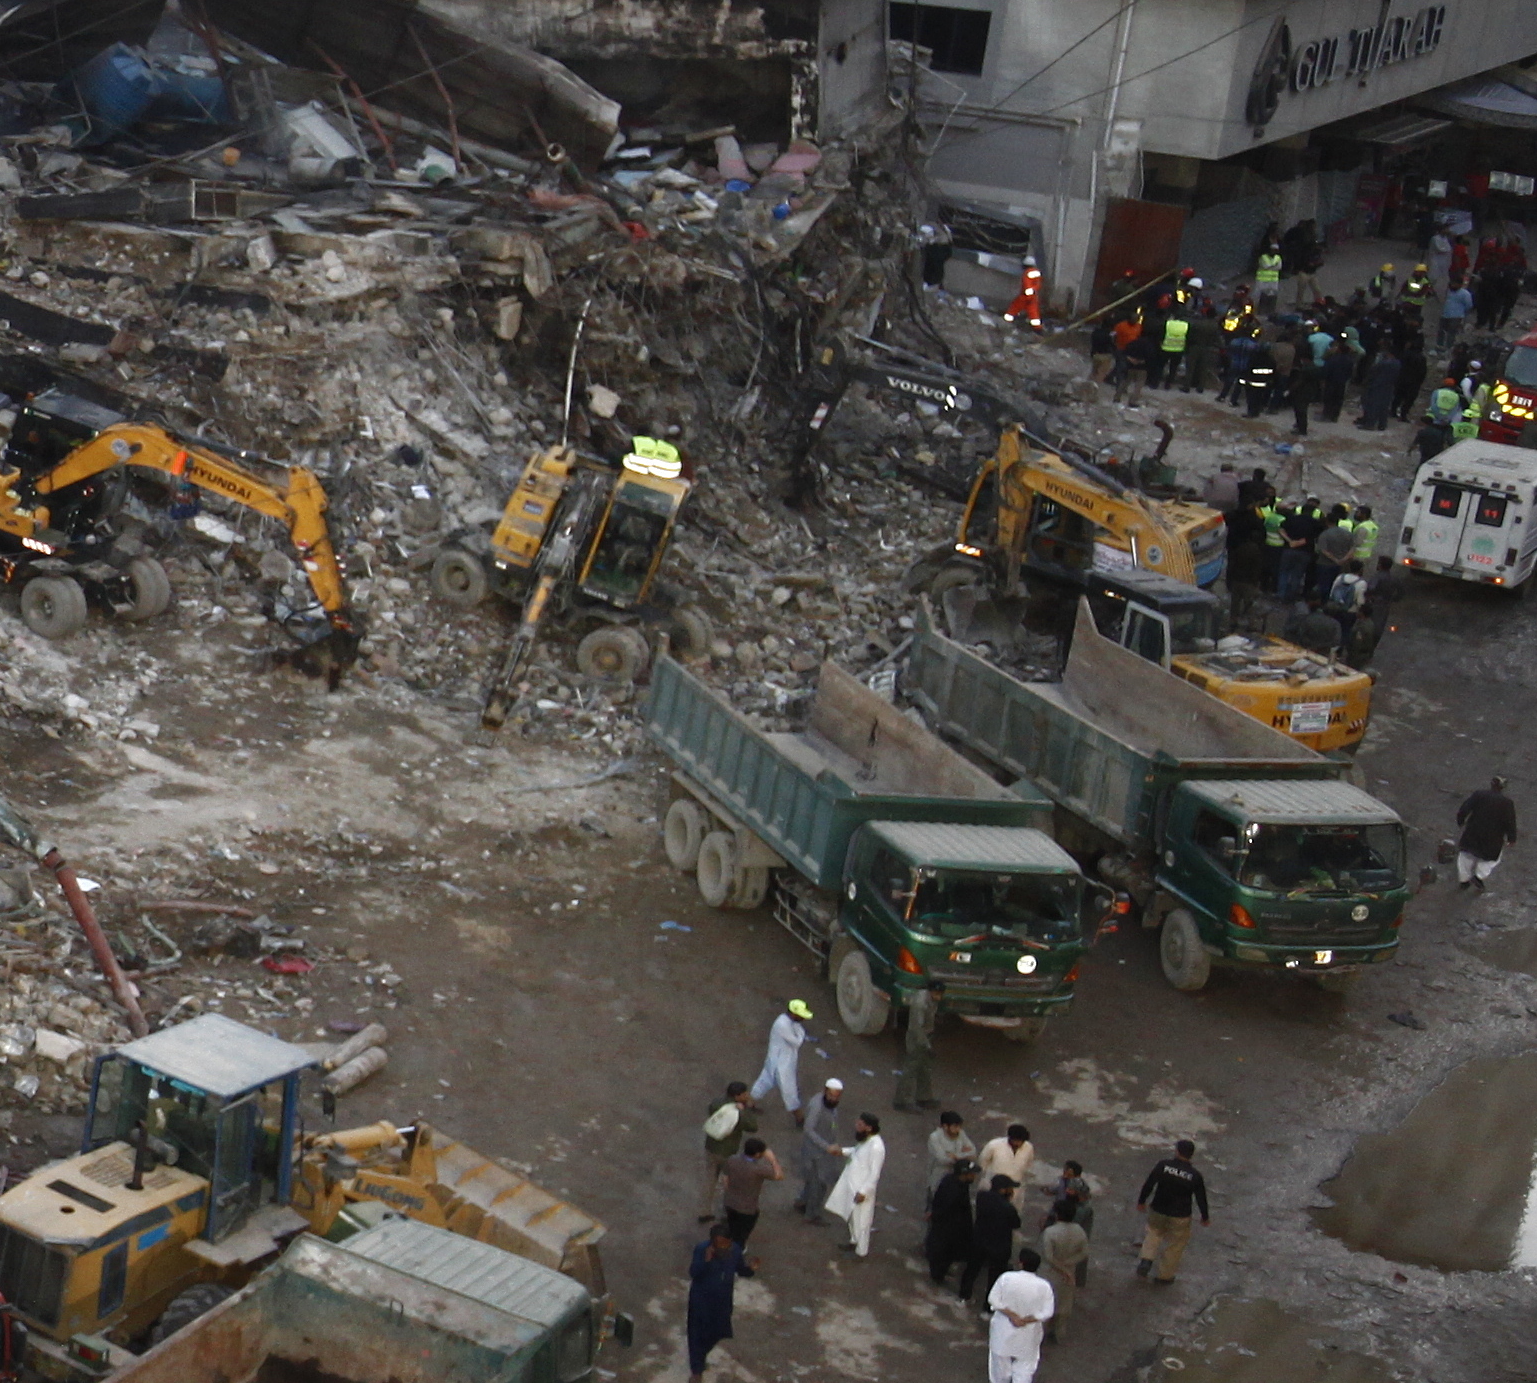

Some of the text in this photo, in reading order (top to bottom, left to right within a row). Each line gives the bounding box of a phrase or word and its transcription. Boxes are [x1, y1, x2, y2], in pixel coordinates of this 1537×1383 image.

[1290, 36, 1346, 92] GUL
[886, 376, 946, 401] VOLVO
[1046, 480, 1095, 511] HYUNDAI
[1163, 1165, 1194, 1181] POLICE
